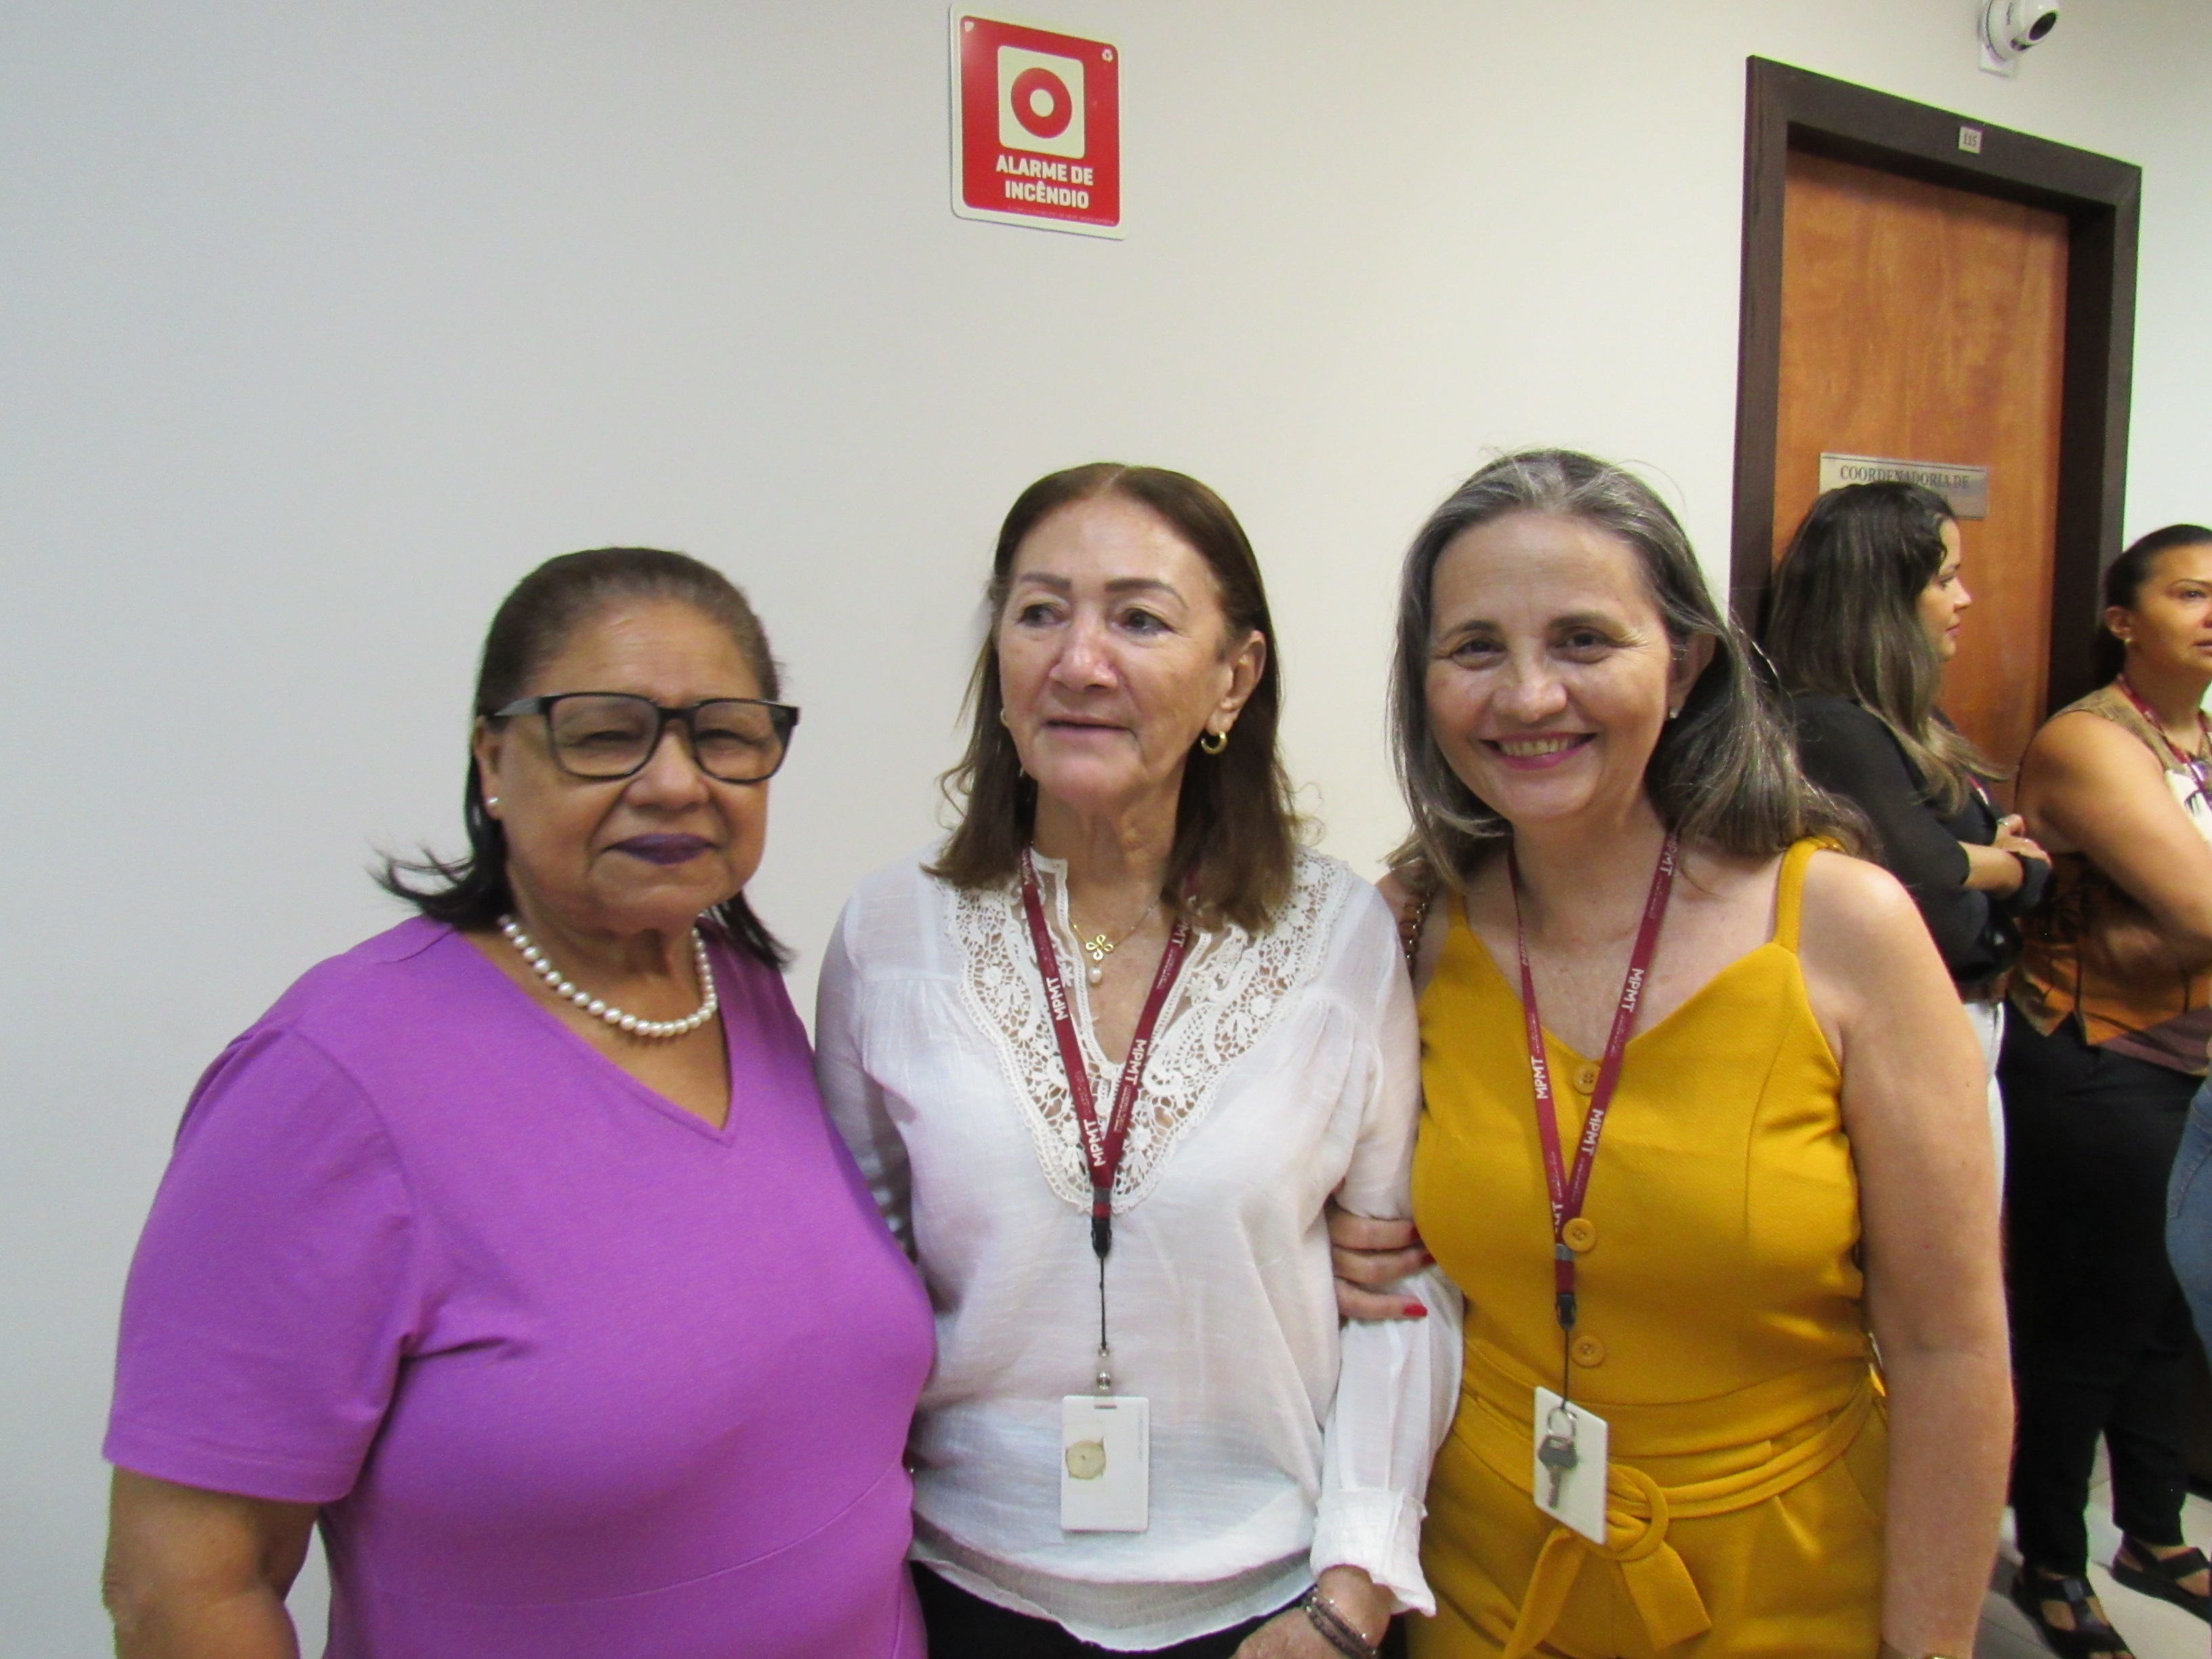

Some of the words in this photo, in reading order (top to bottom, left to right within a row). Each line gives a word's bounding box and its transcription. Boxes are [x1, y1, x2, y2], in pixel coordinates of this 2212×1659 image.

[996, 154, 1067, 182] ALARME
[1071, 165, 1094, 186] DE
[1005, 180, 1089, 209] INCÊNDIO
[1953, 474, 1969, 489] DE
[1046, 977, 1069, 1021] MPMT
[1622, 968, 1644, 1013] MPMT
[1125, 1039, 1147, 1086] MPMT
[1530, 1055, 1549, 1100] MPMT
[1084, 1119, 1106, 1167] MPMT
[1581, 1108, 1605, 1156] MPMT
